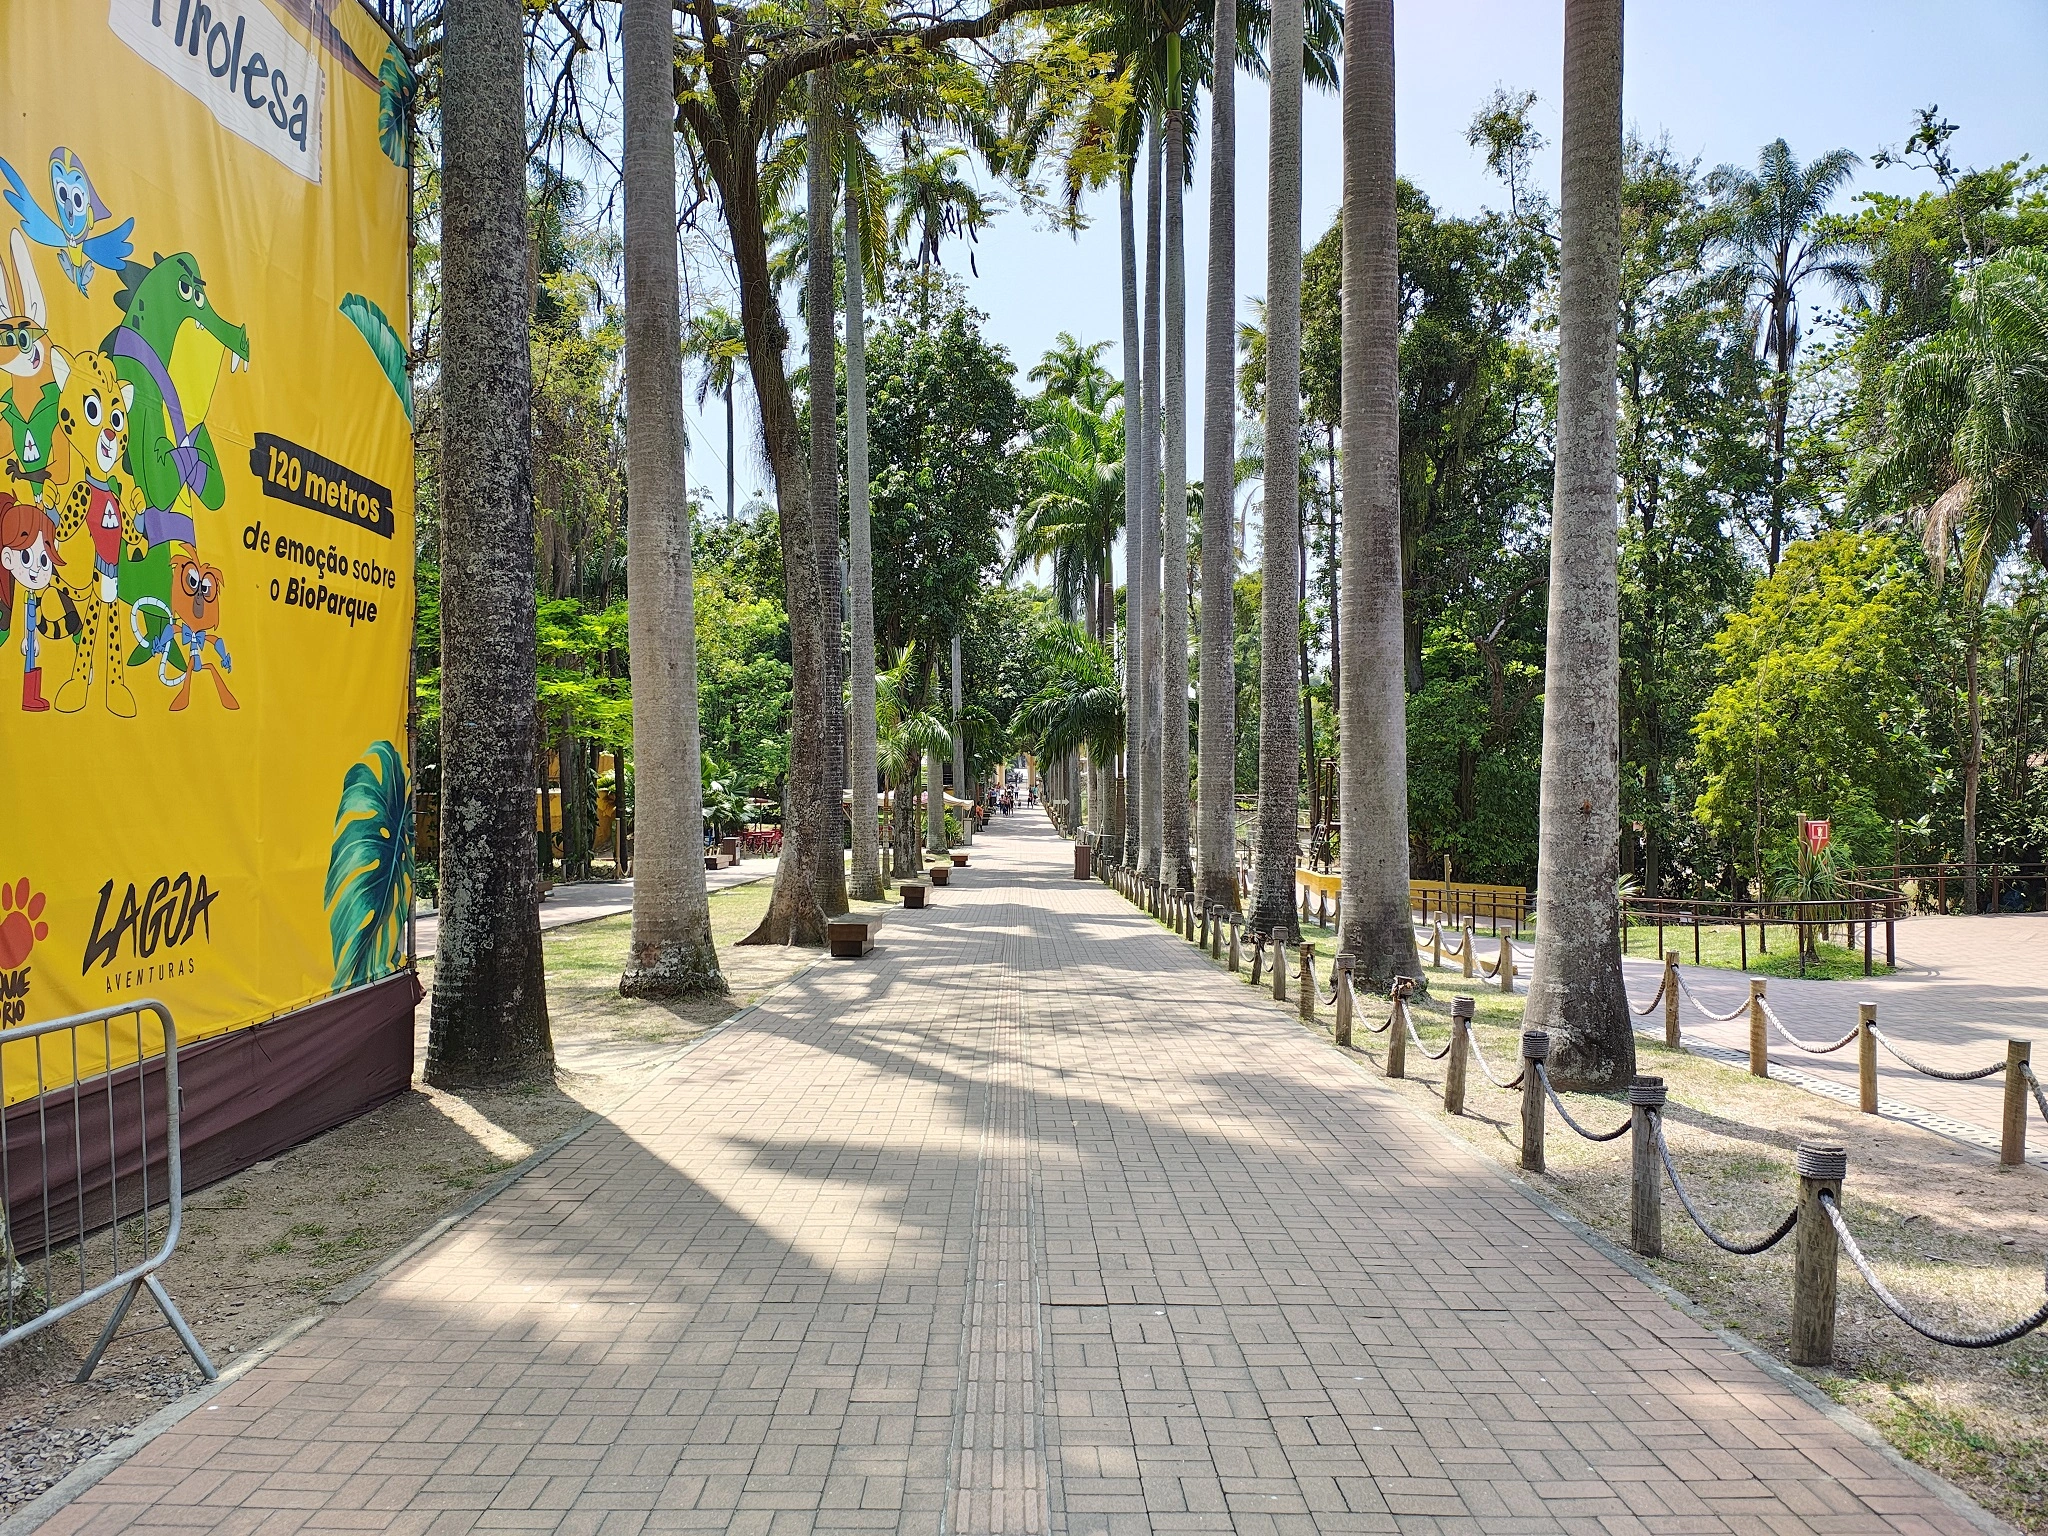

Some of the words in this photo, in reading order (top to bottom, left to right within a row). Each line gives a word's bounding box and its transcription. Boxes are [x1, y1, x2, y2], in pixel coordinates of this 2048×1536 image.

[268, 446, 302, 492] 120
[305, 469, 380, 523] metros
[243, 520, 270, 553] de
[275, 535, 349, 579] emoção
[352, 558, 396, 589] sobre
[270, 578, 280, 601] o
[284, 576, 378, 628] BioParque
[106, 957, 195, 993] AVENTURAS
